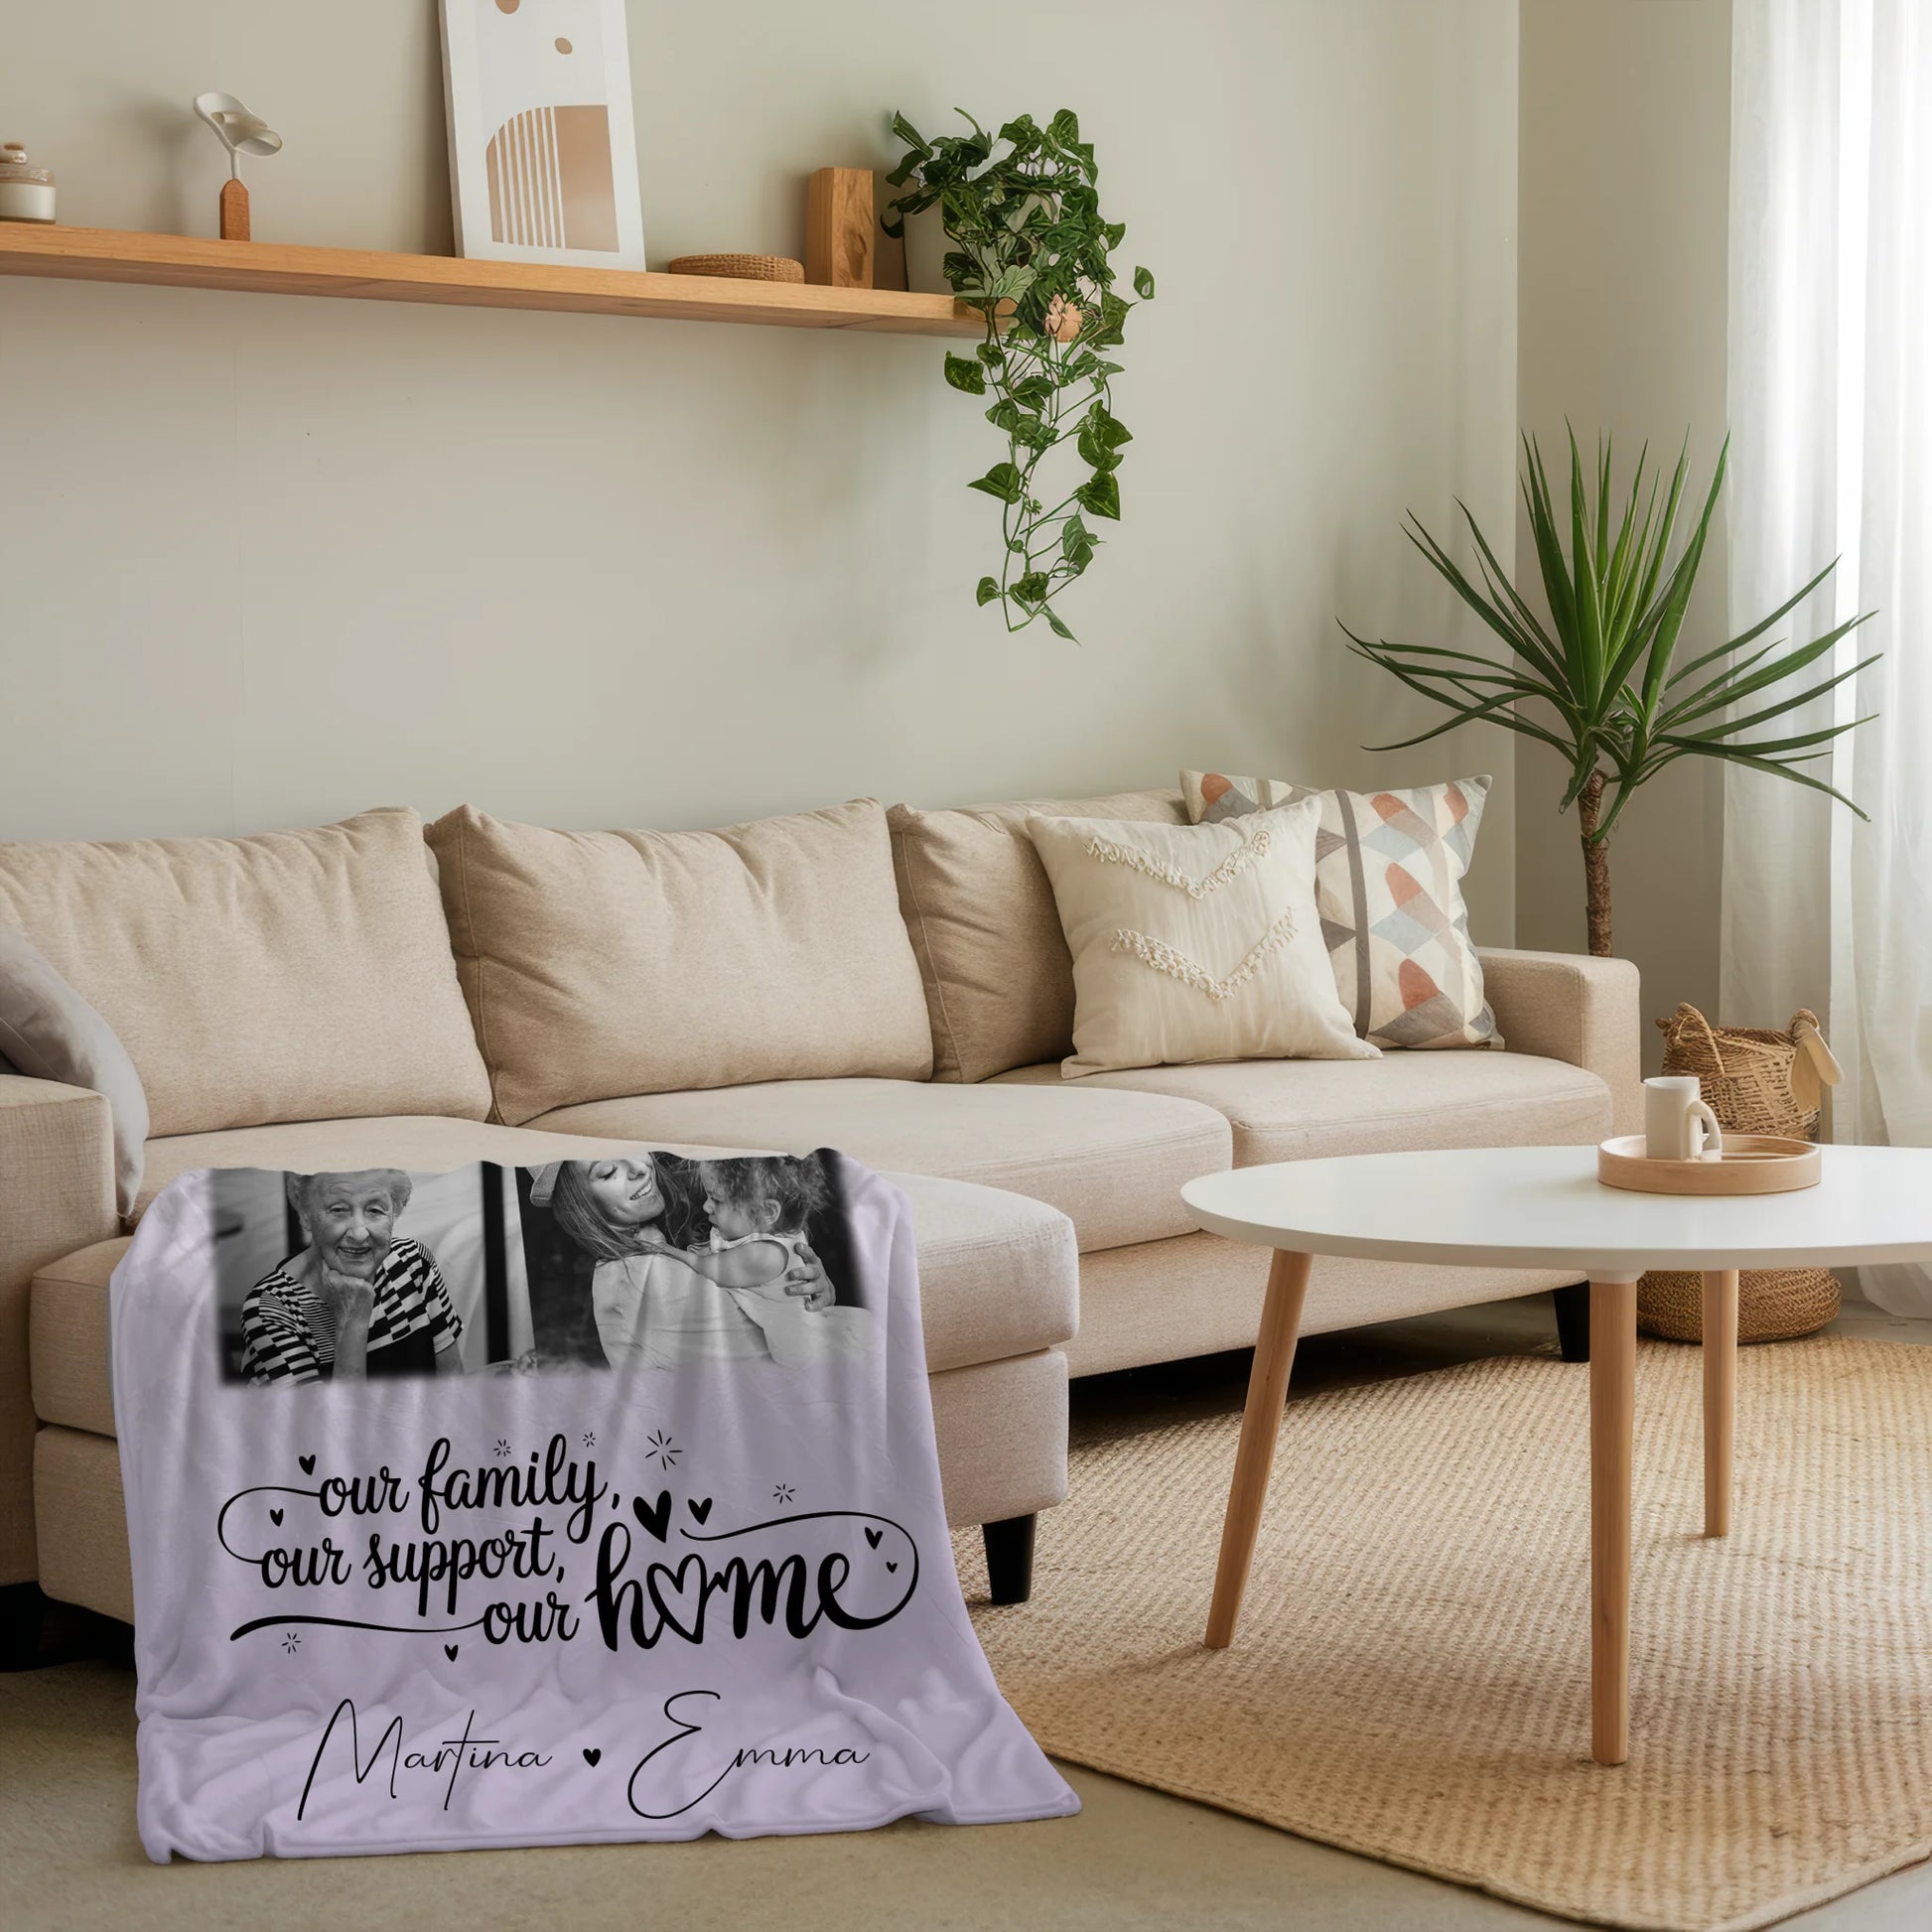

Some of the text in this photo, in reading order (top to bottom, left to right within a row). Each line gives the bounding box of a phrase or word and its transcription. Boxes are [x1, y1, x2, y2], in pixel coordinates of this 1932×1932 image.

[319, 1434, 621, 1545] our family,
[260, 1517, 565, 1618] our support,
[482, 1592, 580, 1645] our
[297, 1690, 871, 1822] Martina Emma
